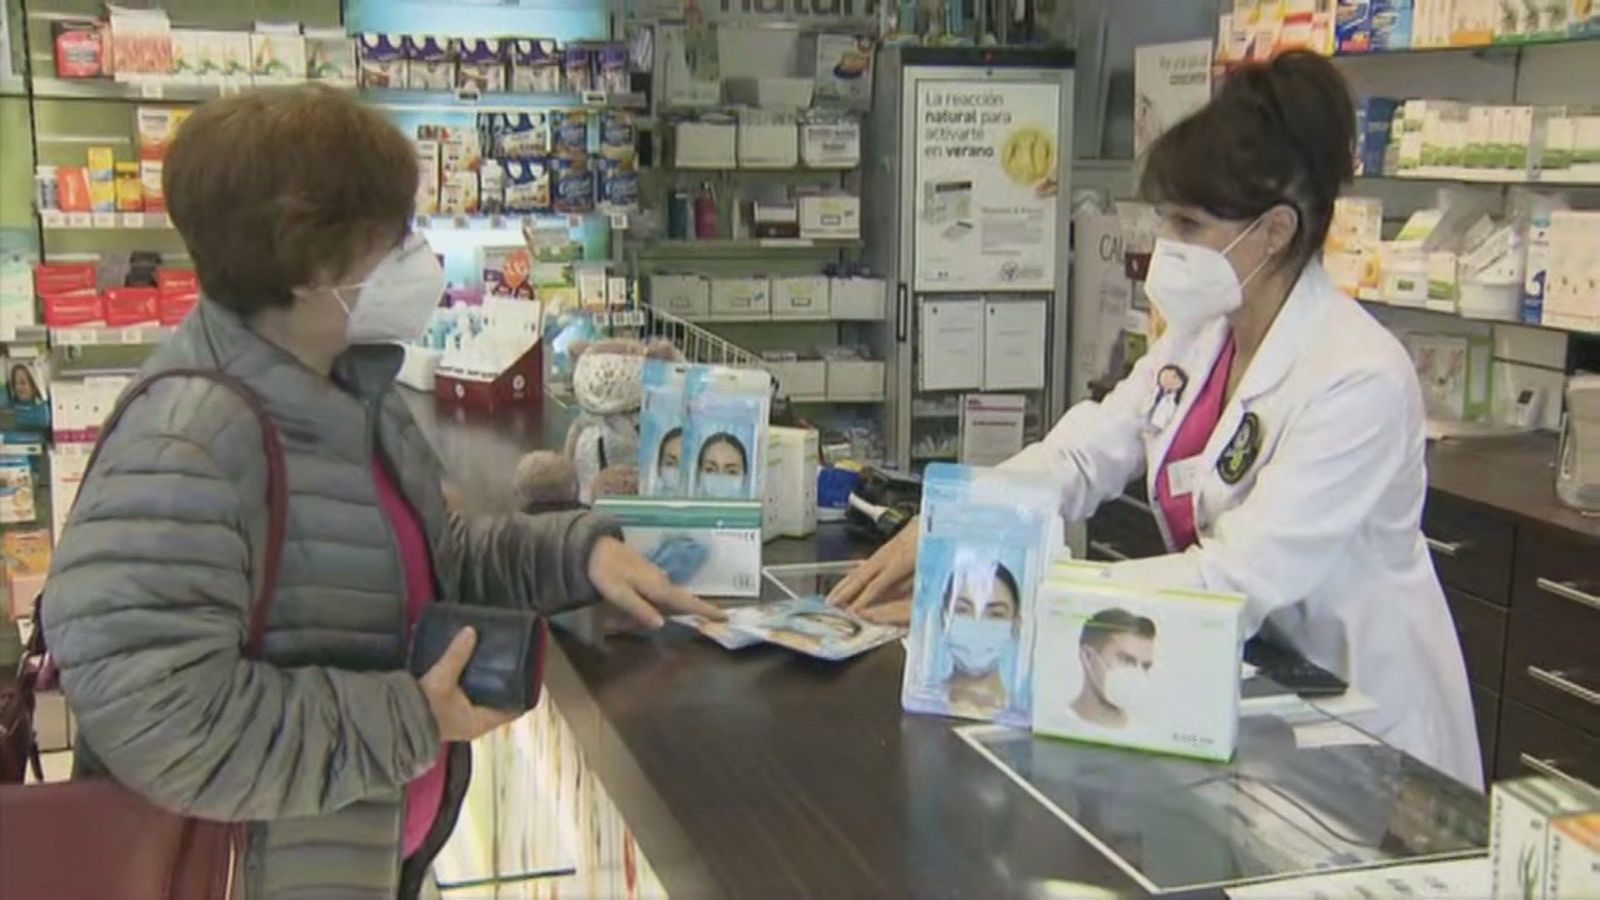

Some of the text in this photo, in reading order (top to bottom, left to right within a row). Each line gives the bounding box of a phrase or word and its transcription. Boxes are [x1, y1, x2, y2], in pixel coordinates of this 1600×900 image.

[925, 89, 1005, 107] La reacción
[925, 109, 1012, 127] natural para
[925, 127, 985, 141] activarte
[924, 146, 994, 158] en verano
